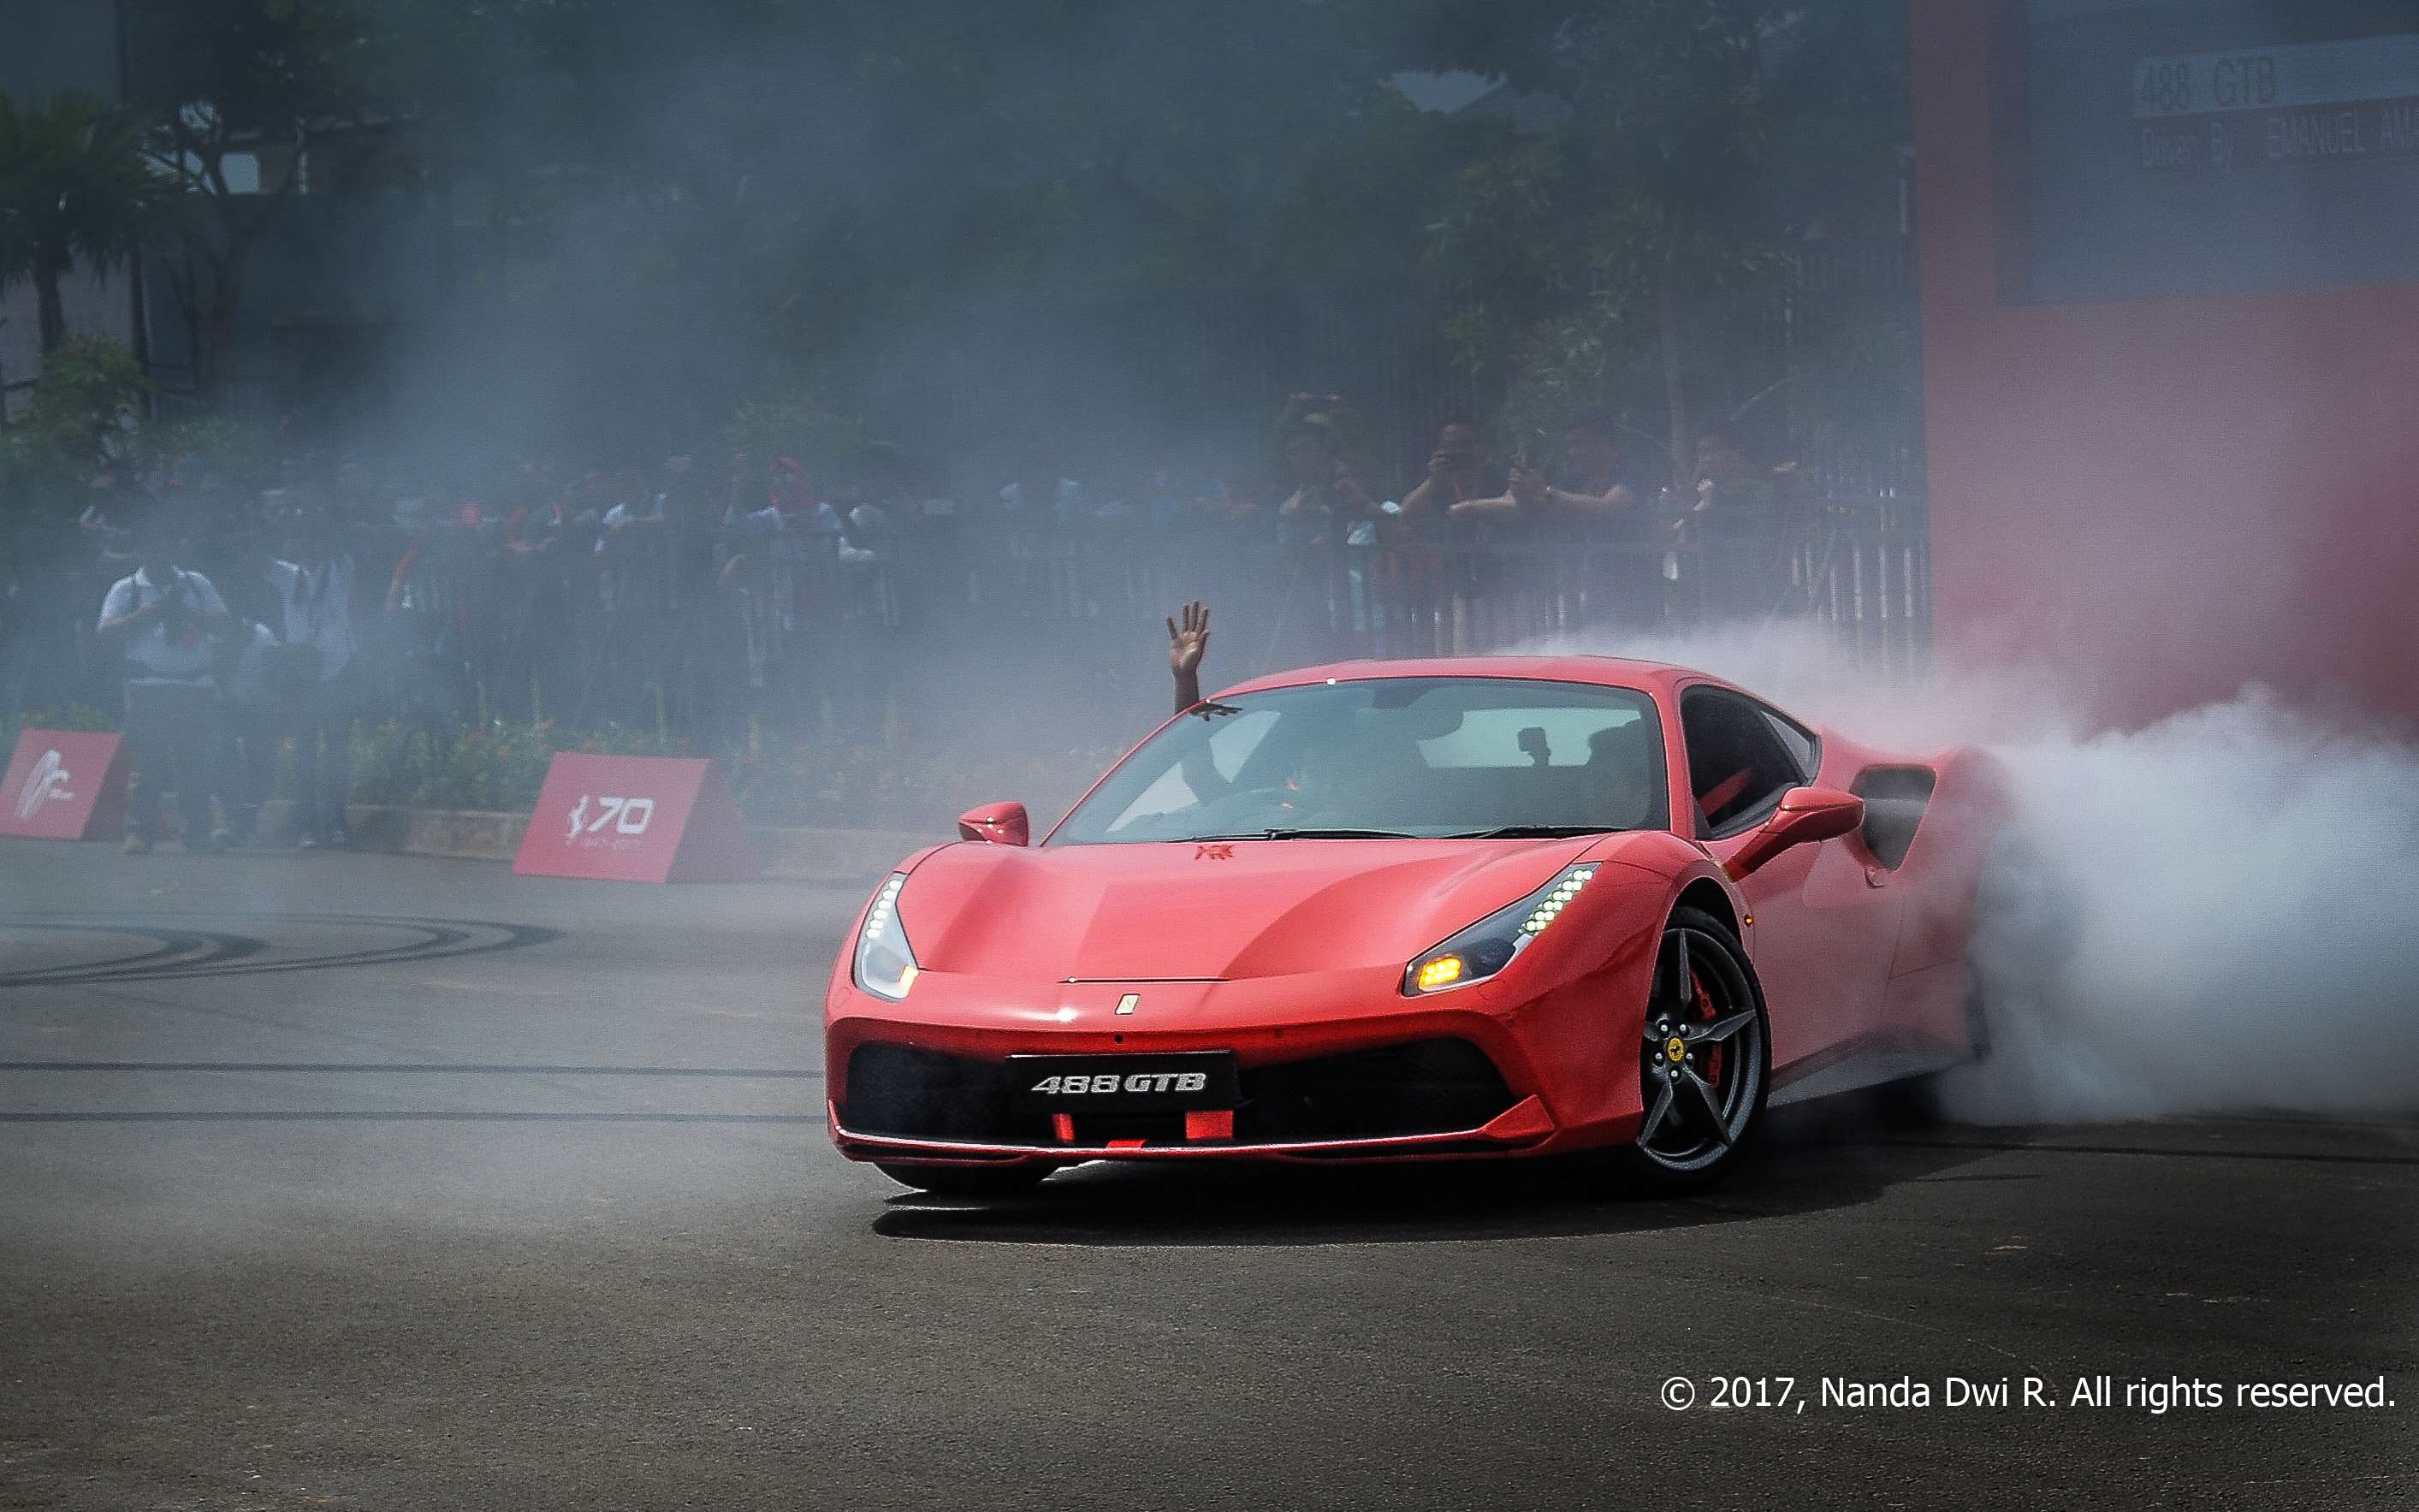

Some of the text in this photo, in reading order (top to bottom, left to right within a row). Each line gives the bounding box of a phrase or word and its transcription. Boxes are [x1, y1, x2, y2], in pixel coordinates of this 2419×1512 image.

[2141, 55, 2276, 111] 488 GTB
[1030, 1072, 1207, 1094] 488 GTB
